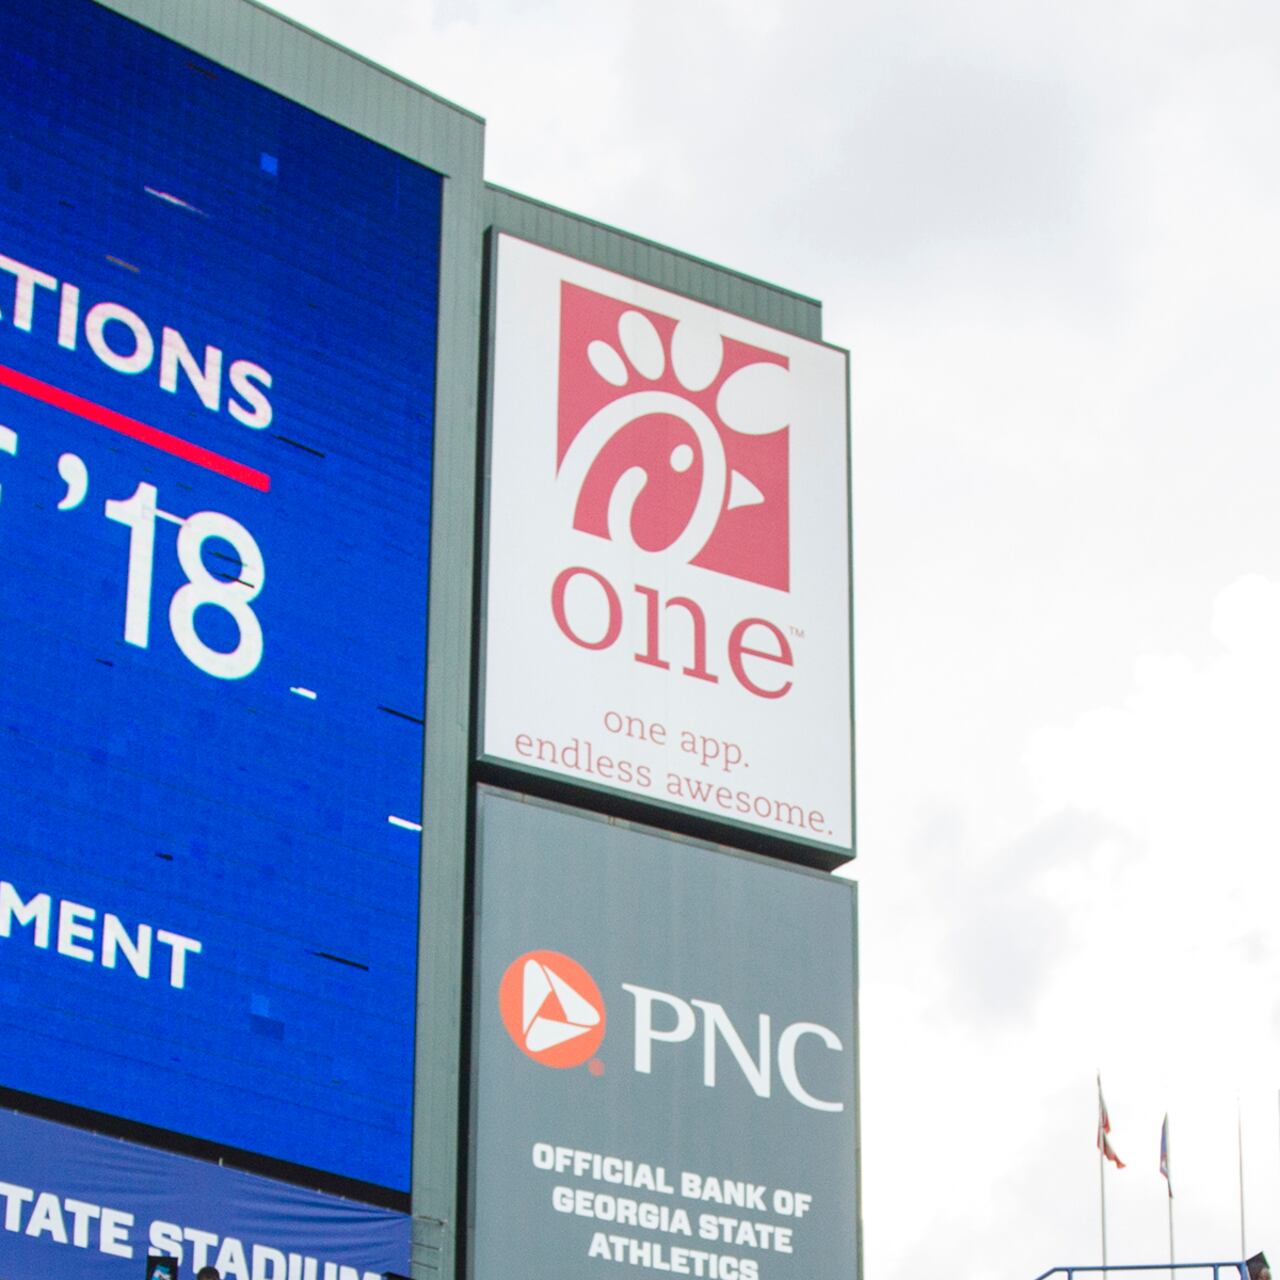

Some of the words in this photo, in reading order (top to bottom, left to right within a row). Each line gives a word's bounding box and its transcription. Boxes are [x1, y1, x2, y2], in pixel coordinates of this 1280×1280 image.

[550, 566, 794, 700] one
[515, 731, 652, 789] endless
[666, 768, 833, 837] awesome.
[603, 709, 667, 747] one
[680, 731, 750, 771] app.
[622, 982, 845, 1113] PNC
[532, 1142, 674, 1196] OFFICIAL
[681, 1171, 766, 1212] BANK
[773, 1189, 812, 1219] OF
[552, 1186, 692, 1236] GEORGIA
[699, 1214, 794, 1254] STATE
